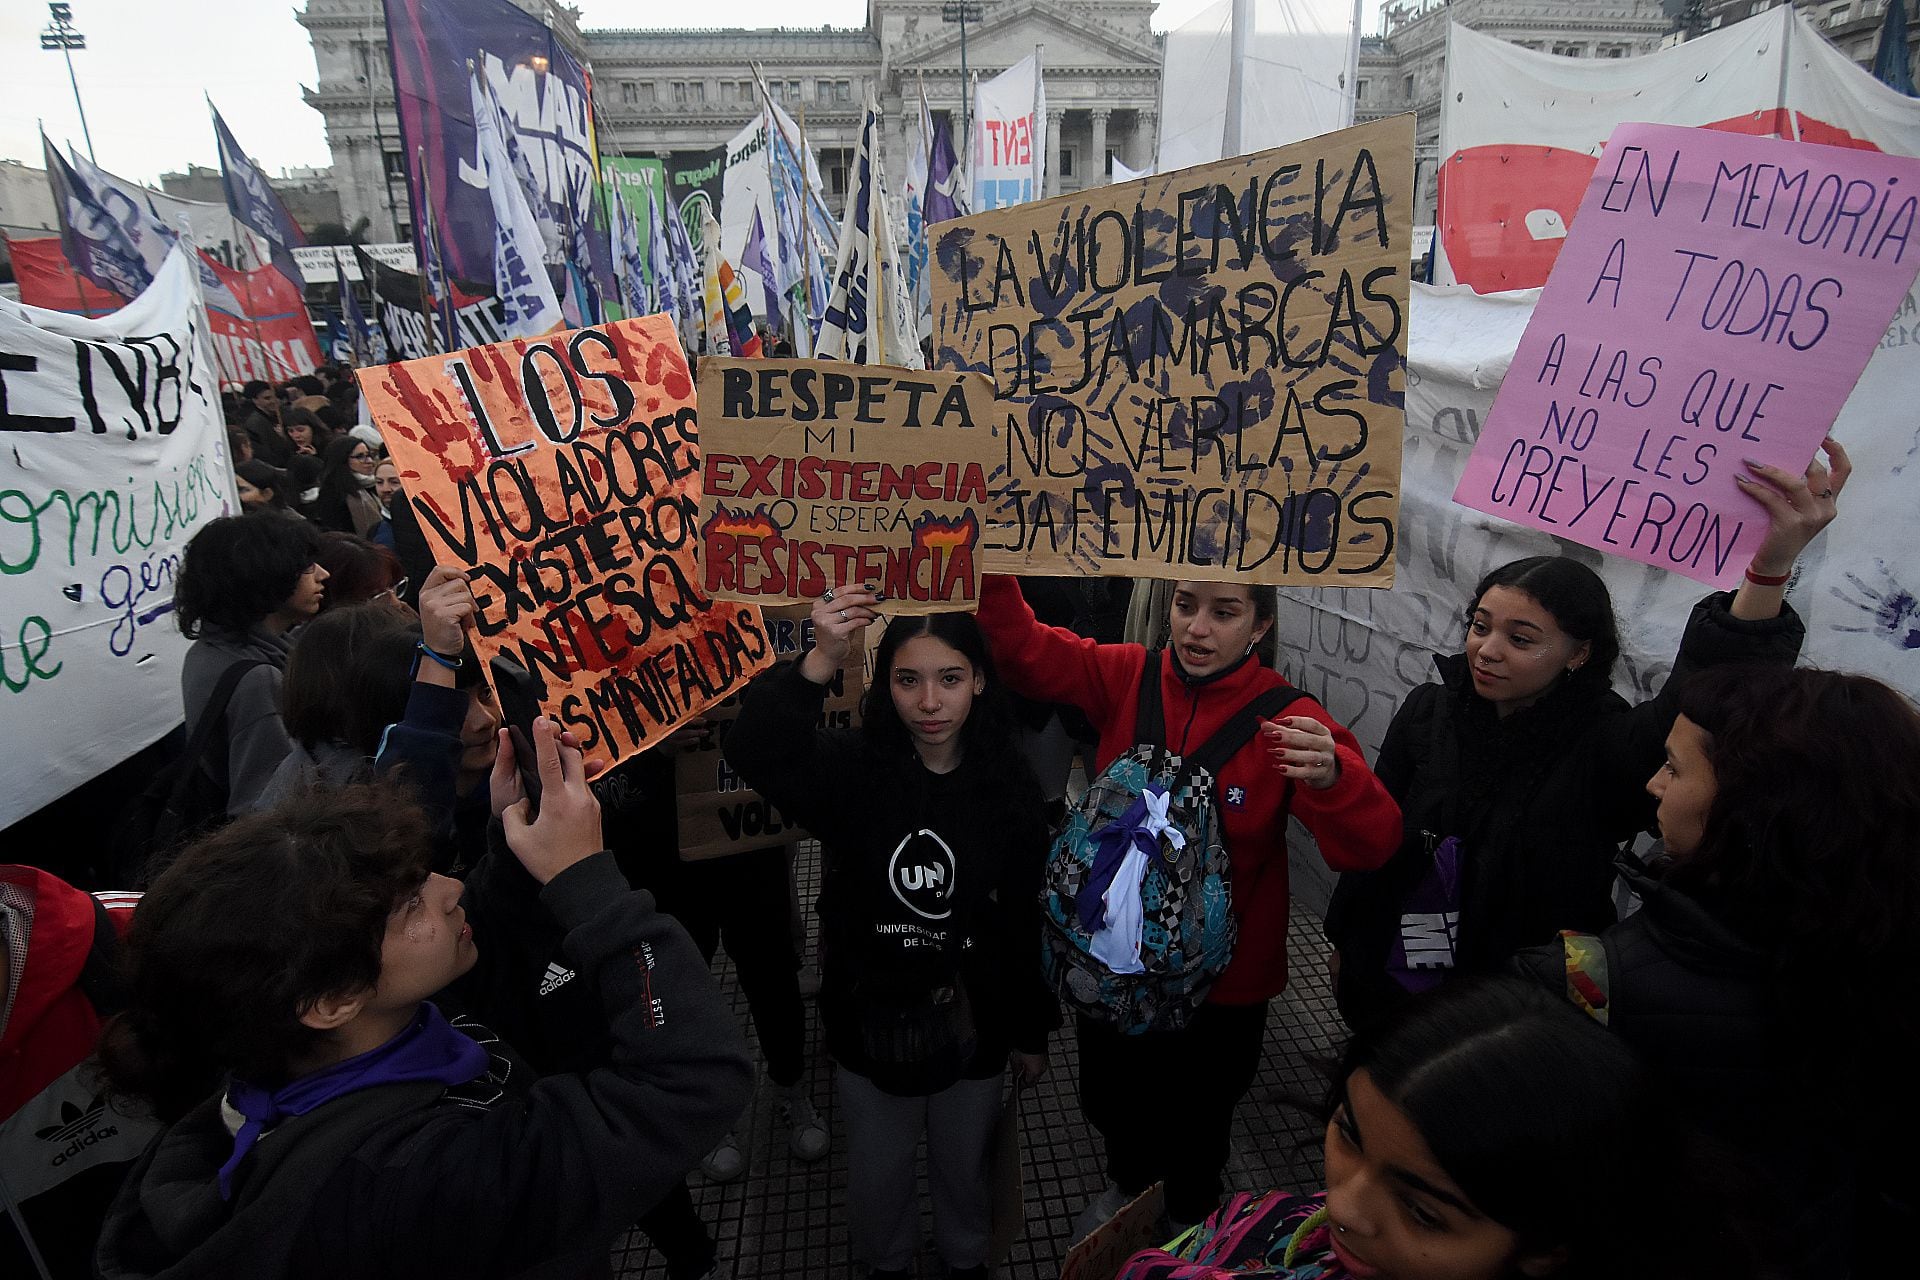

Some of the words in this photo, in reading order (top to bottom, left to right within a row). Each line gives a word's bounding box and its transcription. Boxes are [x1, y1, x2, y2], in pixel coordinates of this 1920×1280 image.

[1601, 146, 1681, 217] EN
[961, 238, 1025, 312] LA
[1031, 148, 1389, 298] VIOLENCIA
[987, 309, 1140, 401] DEJA
[1147, 266, 1401, 378] MARCAS
[1587, 238, 1626, 308] A
[1666, 248, 1843, 351] TODAS
[447, 328, 637, 460] LOS
[722, 366, 975, 428] RESPETÁ
[1005, 404, 1088, 479] NO
[1107, 379, 1369, 476] VERLAS
[1537, 333, 1567, 386] A
[1578, 343, 1662, 408] LAS
[1680, 368, 1785, 442] QUE
[703, 453, 987, 504] EXISTENCIA
[804, 426, 854, 453] MI
[1539, 400, 1599, 452] NO
[1632, 428, 1718, 486] LES
[413, 406, 700, 567] VIOLADORES
[810, 500, 913, 533] ESPERÁ
[1490, 438, 1744, 578] CREYERON
[704, 532, 976, 602] RESISTENCIA
[1070, 486, 1397, 575] FEMICIDIOS
[539, 969, 576, 996] adidas
[903, 937, 919, 948] DE
[51, 1125, 119, 1167] adidas
